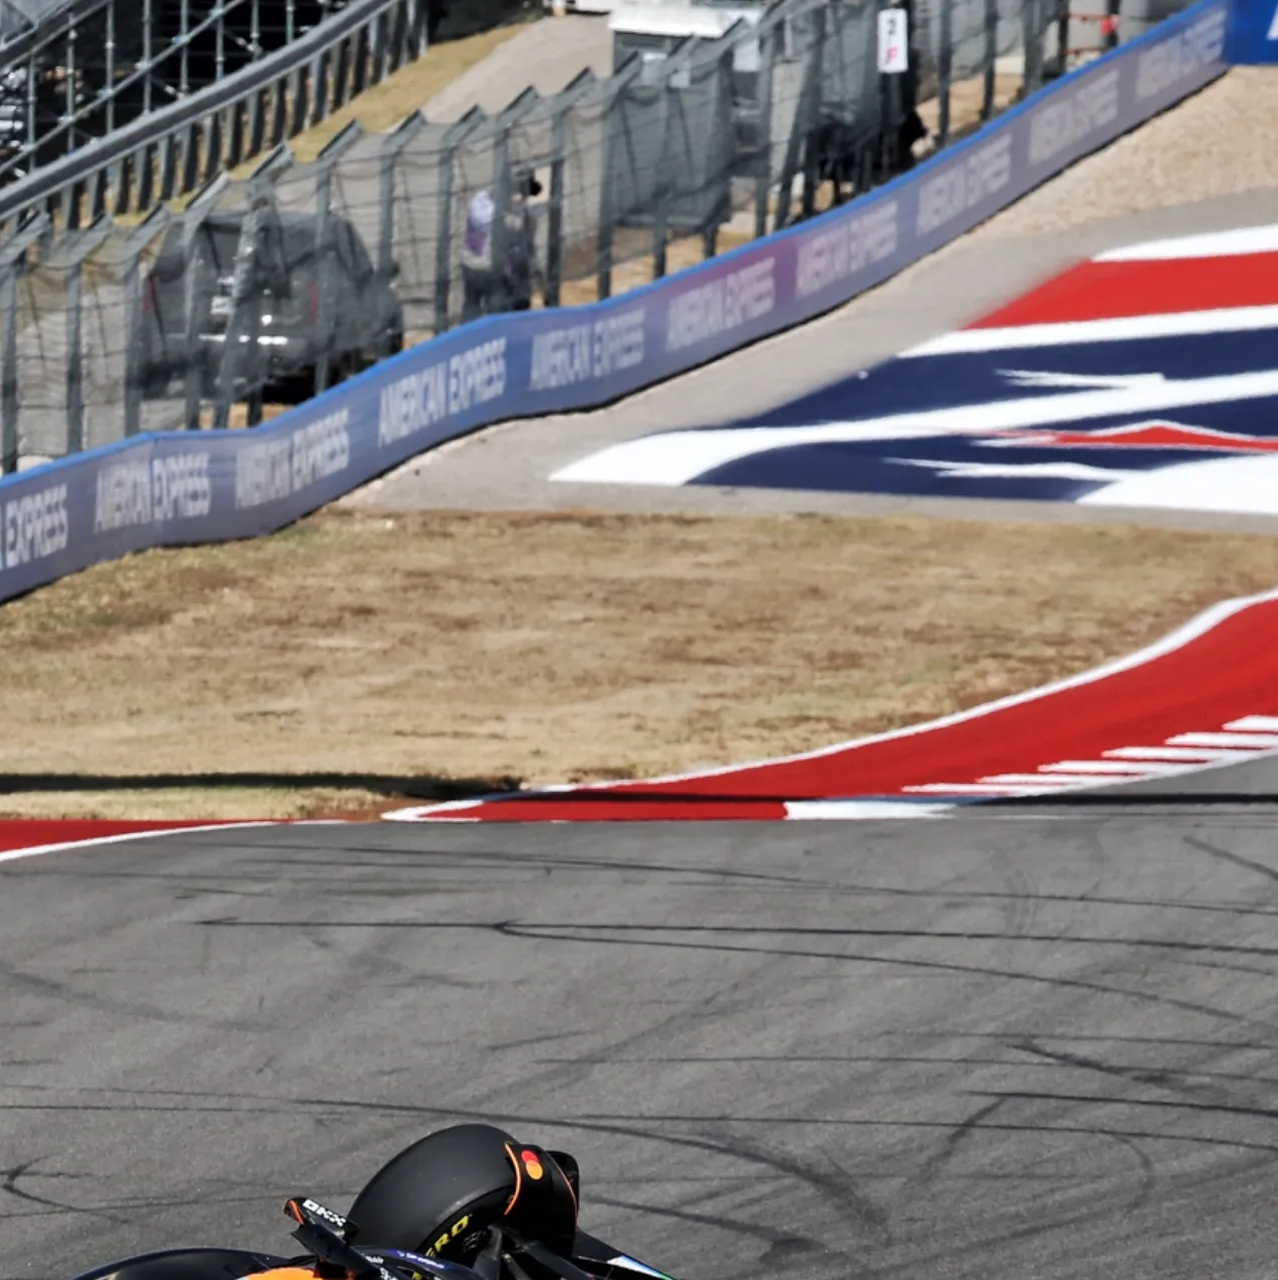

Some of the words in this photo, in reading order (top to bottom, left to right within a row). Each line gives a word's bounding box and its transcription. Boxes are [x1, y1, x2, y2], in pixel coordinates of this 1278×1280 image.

[378, 360, 447, 448] AMERICAN
[448, 335, 507, 414] EXPRESS
[92, 459, 151, 534] AMERICAN
[151, 452, 211, 519] EXPRESS
[234, 437, 292, 510] AMERICAN
[292, 408, 350, 493] EXPRESS
[5, 483, 68, 568] EXPRESS
